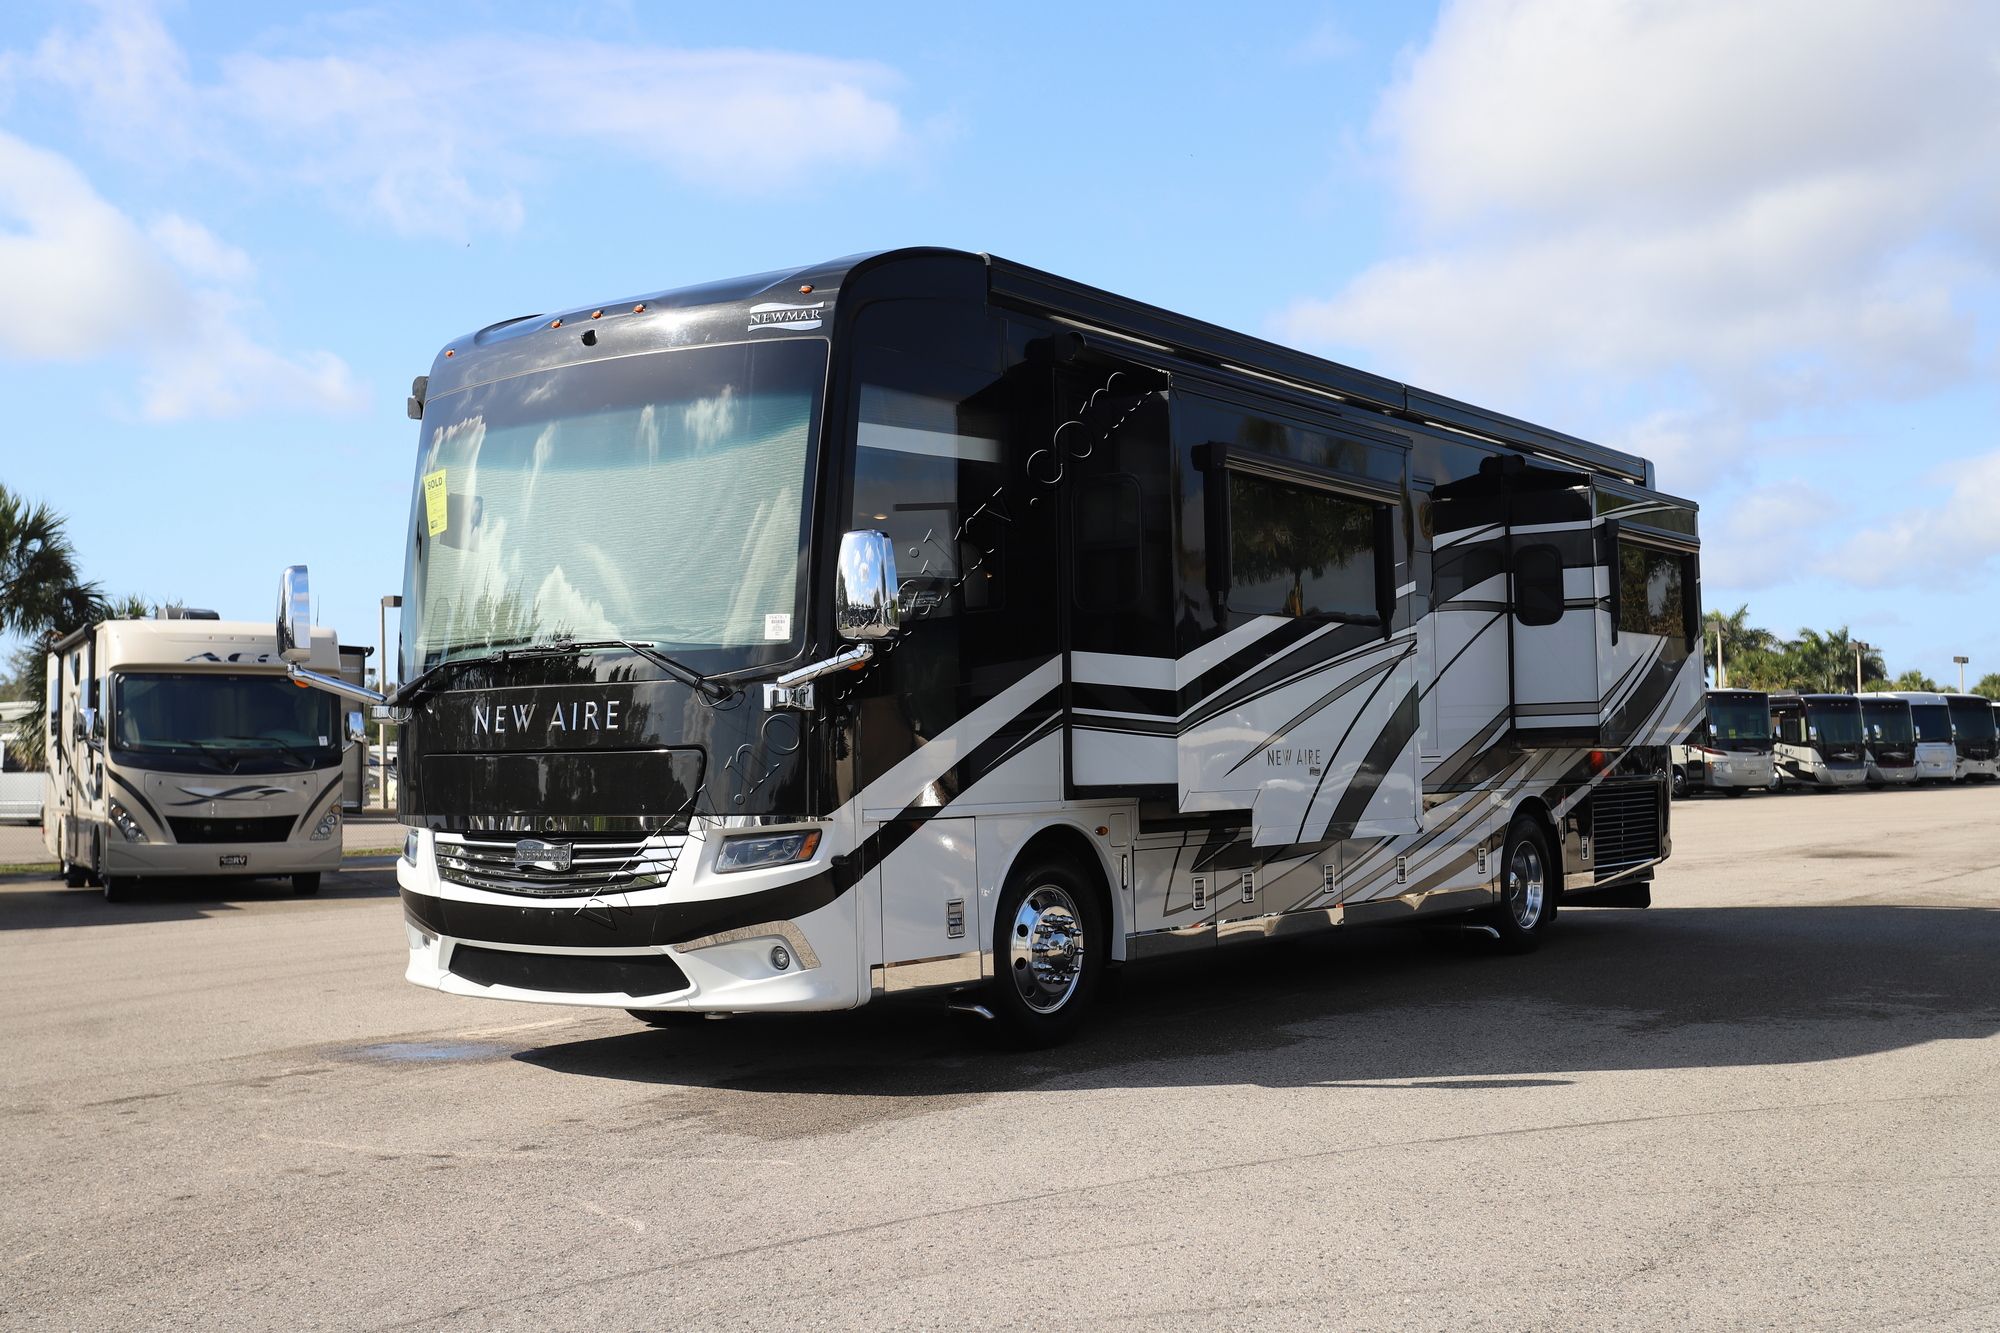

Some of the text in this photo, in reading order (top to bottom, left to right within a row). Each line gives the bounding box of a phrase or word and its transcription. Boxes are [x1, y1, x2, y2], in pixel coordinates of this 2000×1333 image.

[749, 309, 822, 325] NEWMAR
[427, 477, 443, 491] SOLD
[474, 700, 620, 735] NEW AIRE
[1267, 748, 1320, 767] NEW AIRE
